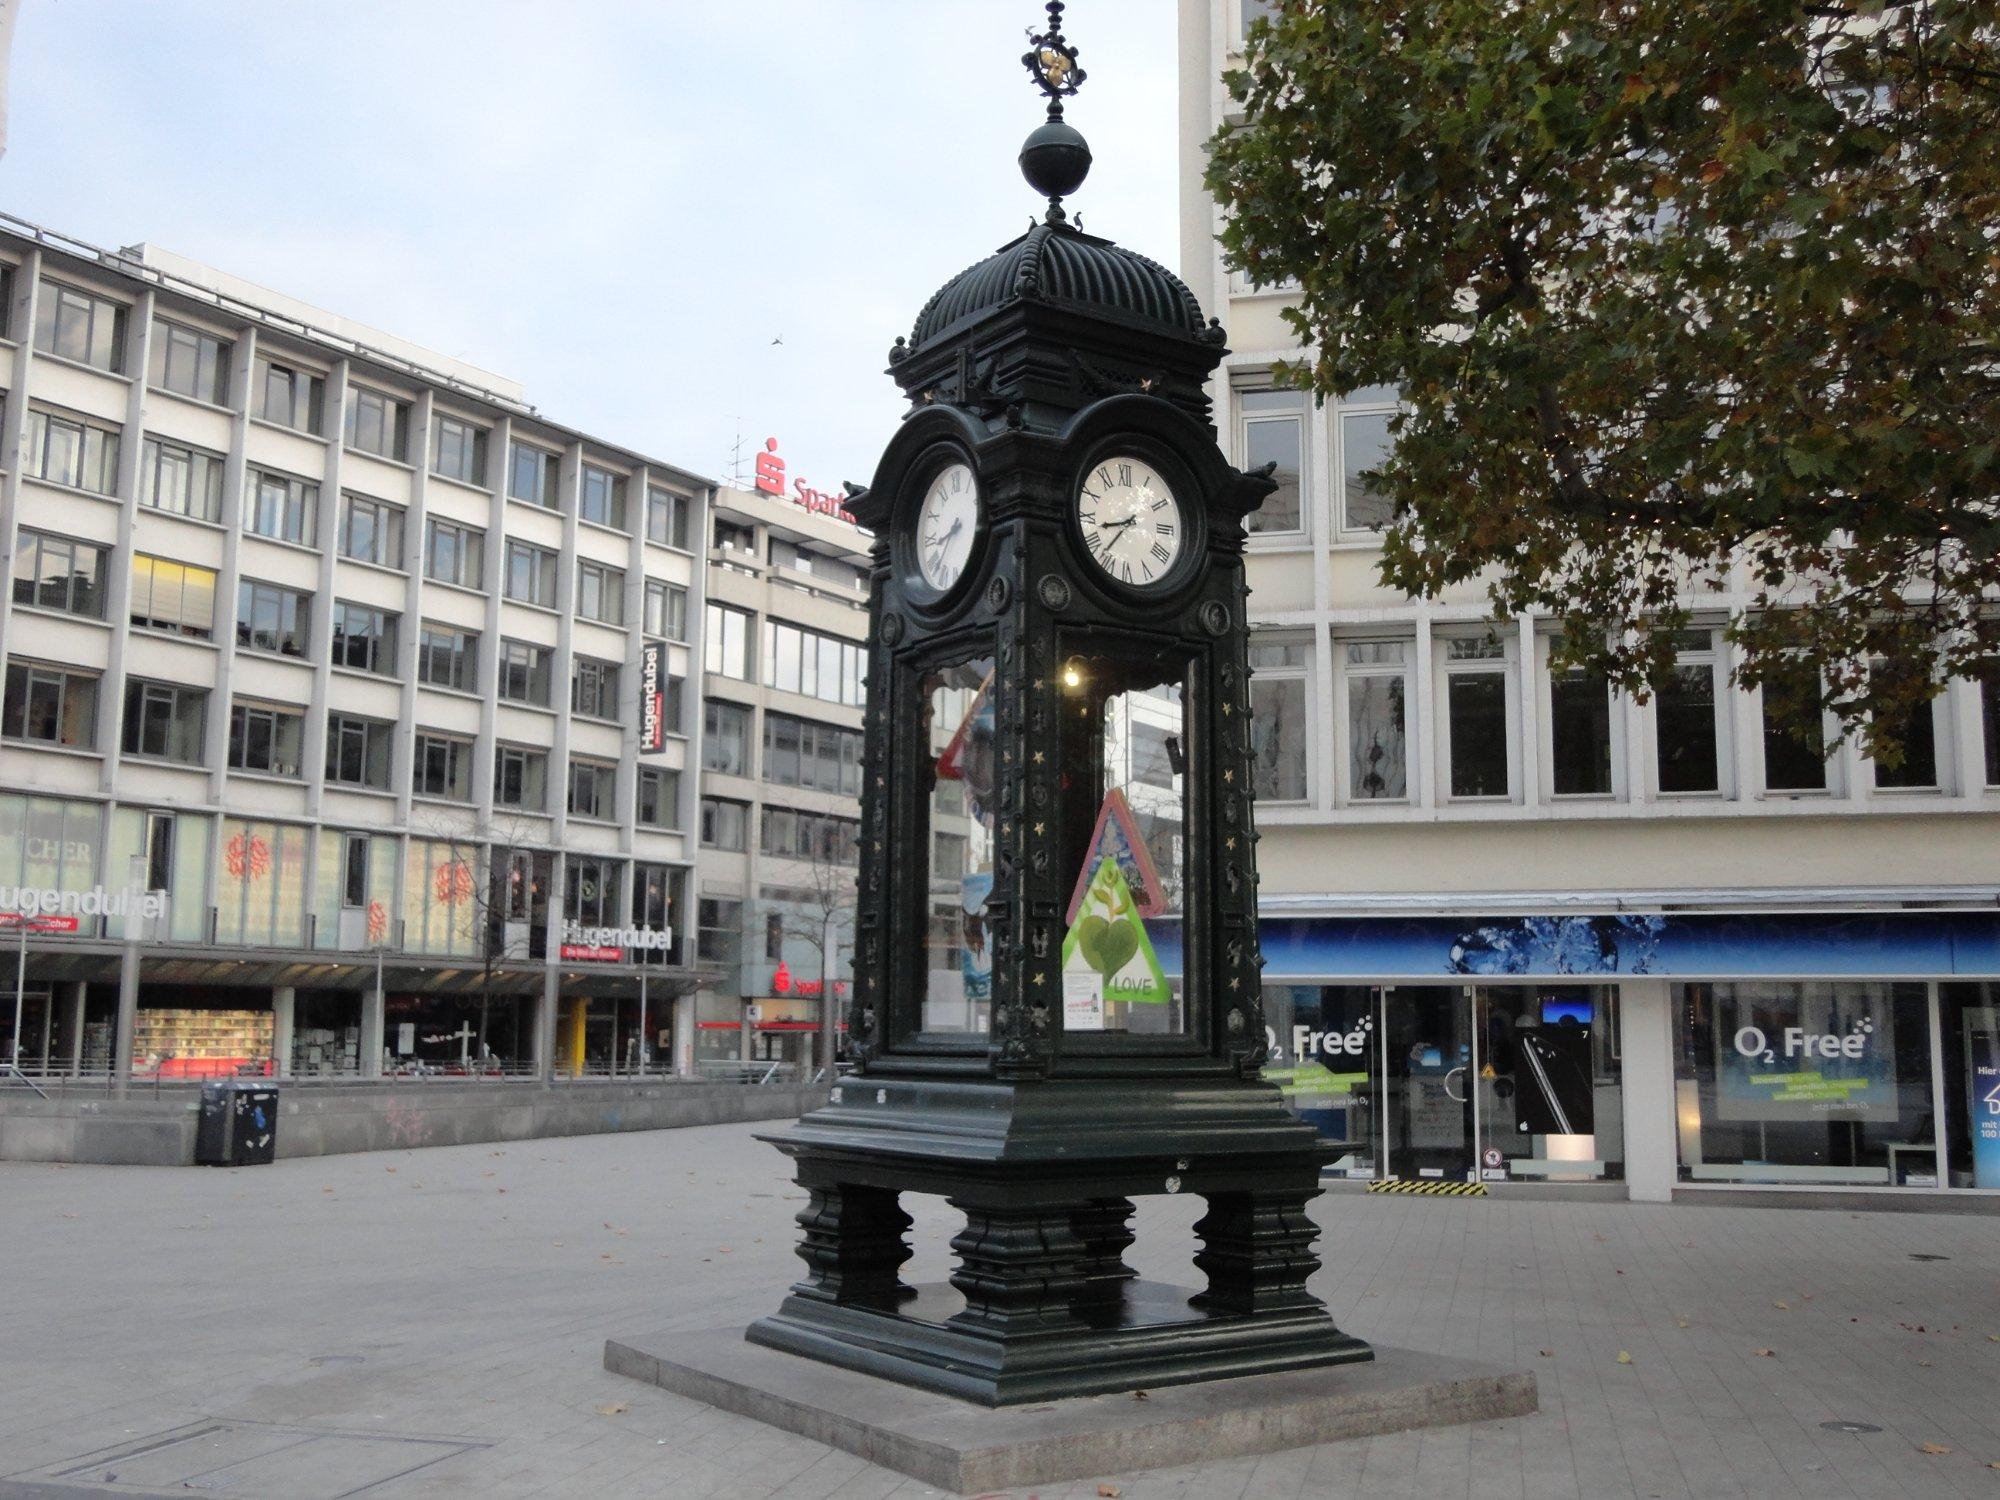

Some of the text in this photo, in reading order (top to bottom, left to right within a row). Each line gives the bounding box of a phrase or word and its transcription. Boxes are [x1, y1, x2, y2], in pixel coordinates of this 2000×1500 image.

[1097, 466, 1114, 491] XI
[1118, 464, 1132, 488] XII
[1081, 485, 1101, 504] X
[1152, 498, 1168, 512] II
[1157, 523, 1174, 536] III
[641, 647, 658, 749] Hugendubel
[561, 918, 672, 950] Hugendubel
[1114, 976, 1152, 996] LOVE
[1293, 1024, 1366, 1055] Free
[1582, 1030, 1589, 1039] 7
[1784, 1027, 1866, 1058] Free
[1978, 1066, 1997, 1075] Hier
[1981, 1121, 1997, 1129] mit
[1981, 1130, 1997, 1138] 100
